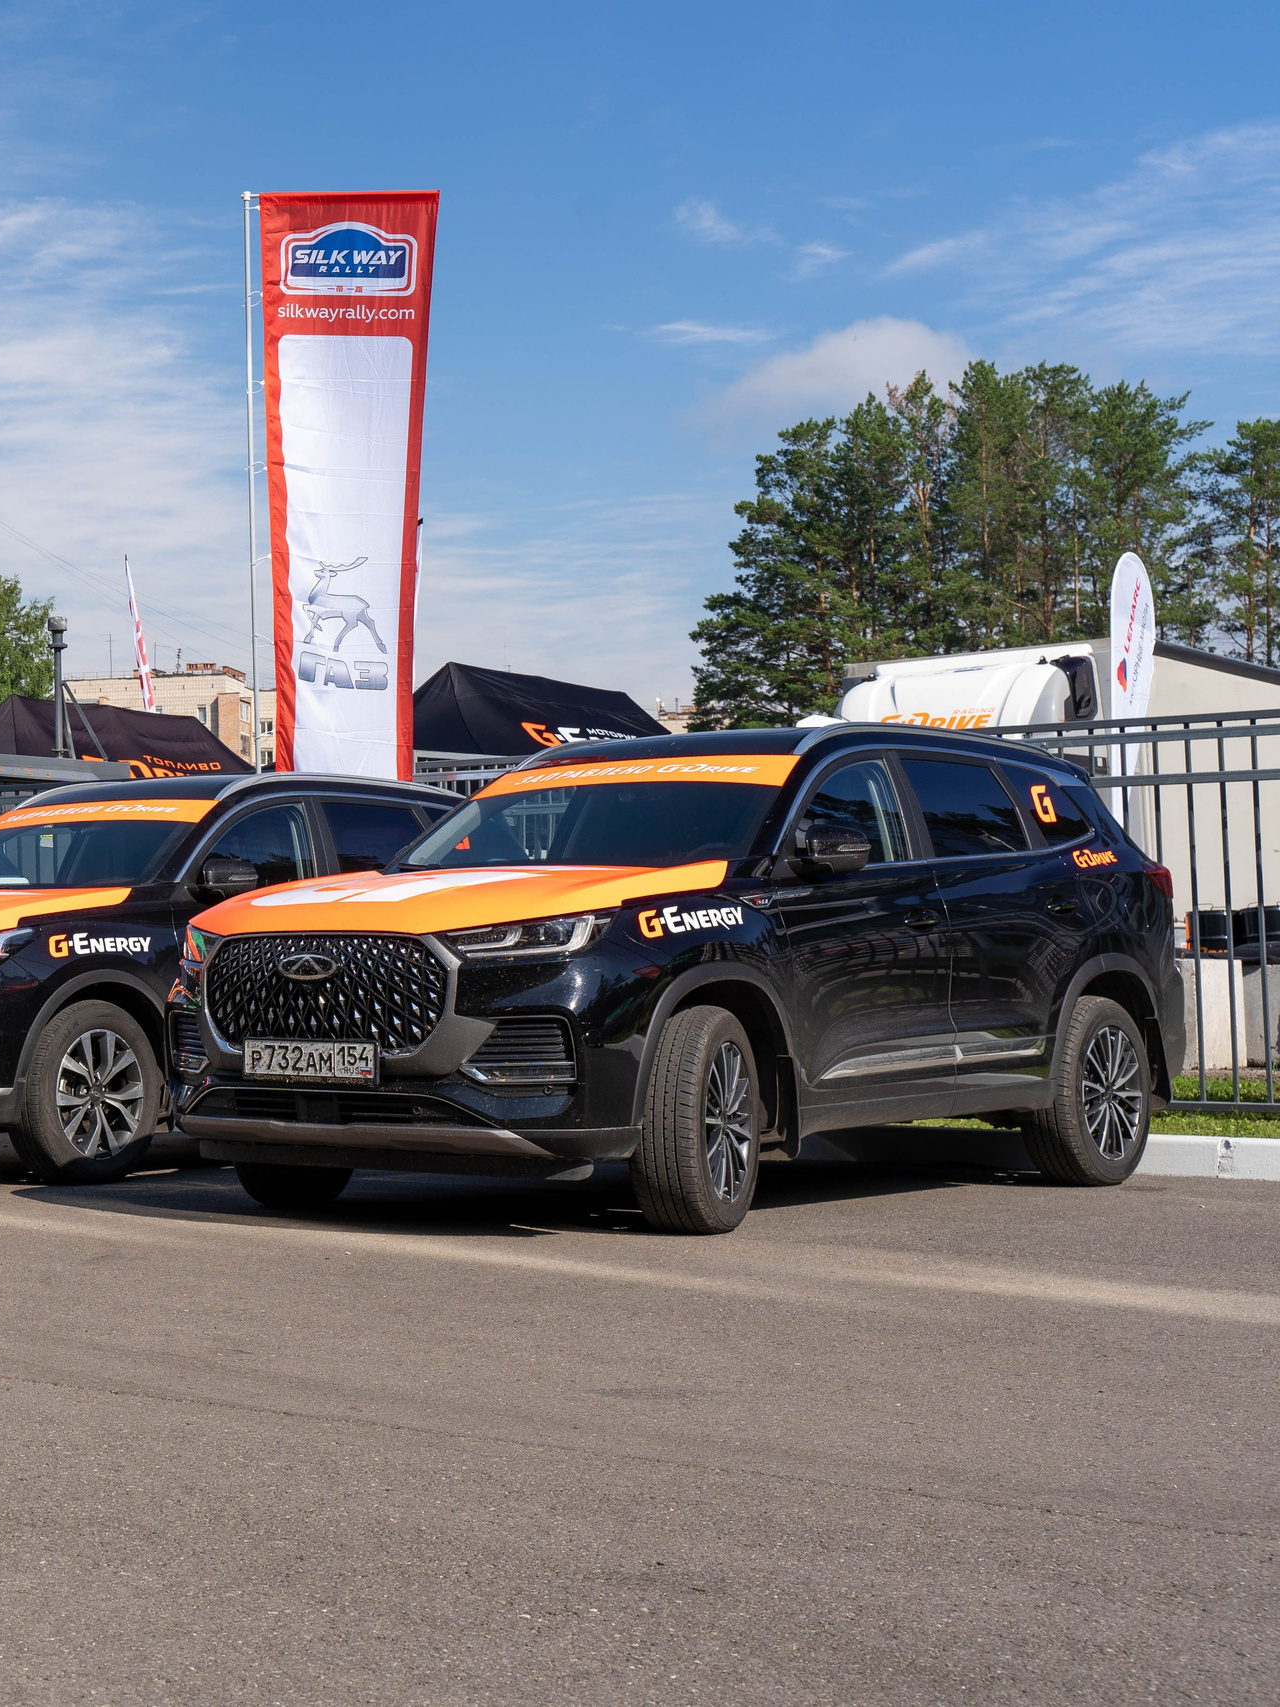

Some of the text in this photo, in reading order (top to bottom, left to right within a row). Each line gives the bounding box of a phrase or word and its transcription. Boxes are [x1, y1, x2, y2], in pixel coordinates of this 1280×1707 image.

[293, 250, 405, 265] SILK WAY
[318, 265, 377, 274] RALLY
[277, 303, 415, 323] silkwayrally.com
[1123, 577, 1141, 654] LEMARC
[298, 650, 388, 690] ГАЗ
[952, 706, 996, 716] RACING
[143, 755, 221, 771] ТОПЛИВО
[514, 765, 656, 786] ЗАПРАВЛЕНО
[251, 1044, 369, 1073] Р732АМ 154
[343, 1066, 359, 1075] RUS
